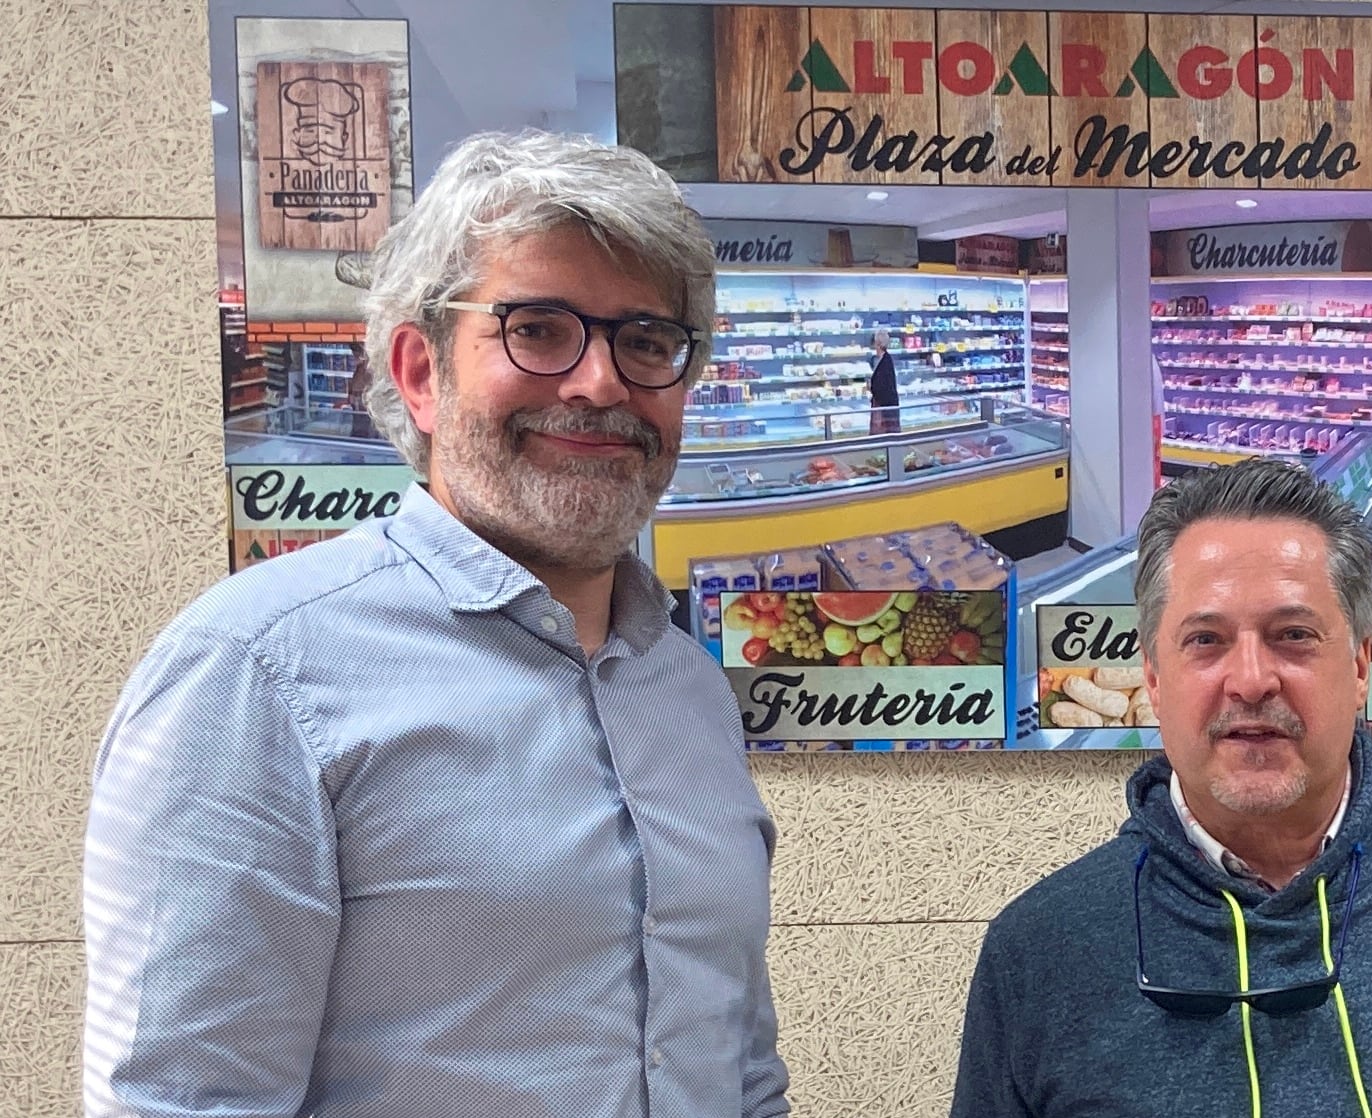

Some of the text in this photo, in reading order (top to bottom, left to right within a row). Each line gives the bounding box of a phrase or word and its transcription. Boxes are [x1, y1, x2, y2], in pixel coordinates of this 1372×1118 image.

[784, 28, 1354, 100] ALTOARAGÓN
[779, 106, 1361, 180] Plaza del Mercado
[716, 234, 794, 262] mería
[1187, 232, 1338, 270] Charcutería
[236, 469, 401, 521] Charc
[1052, 611, 1140, 662] Ela
[743, 672, 996, 734] Frutería
